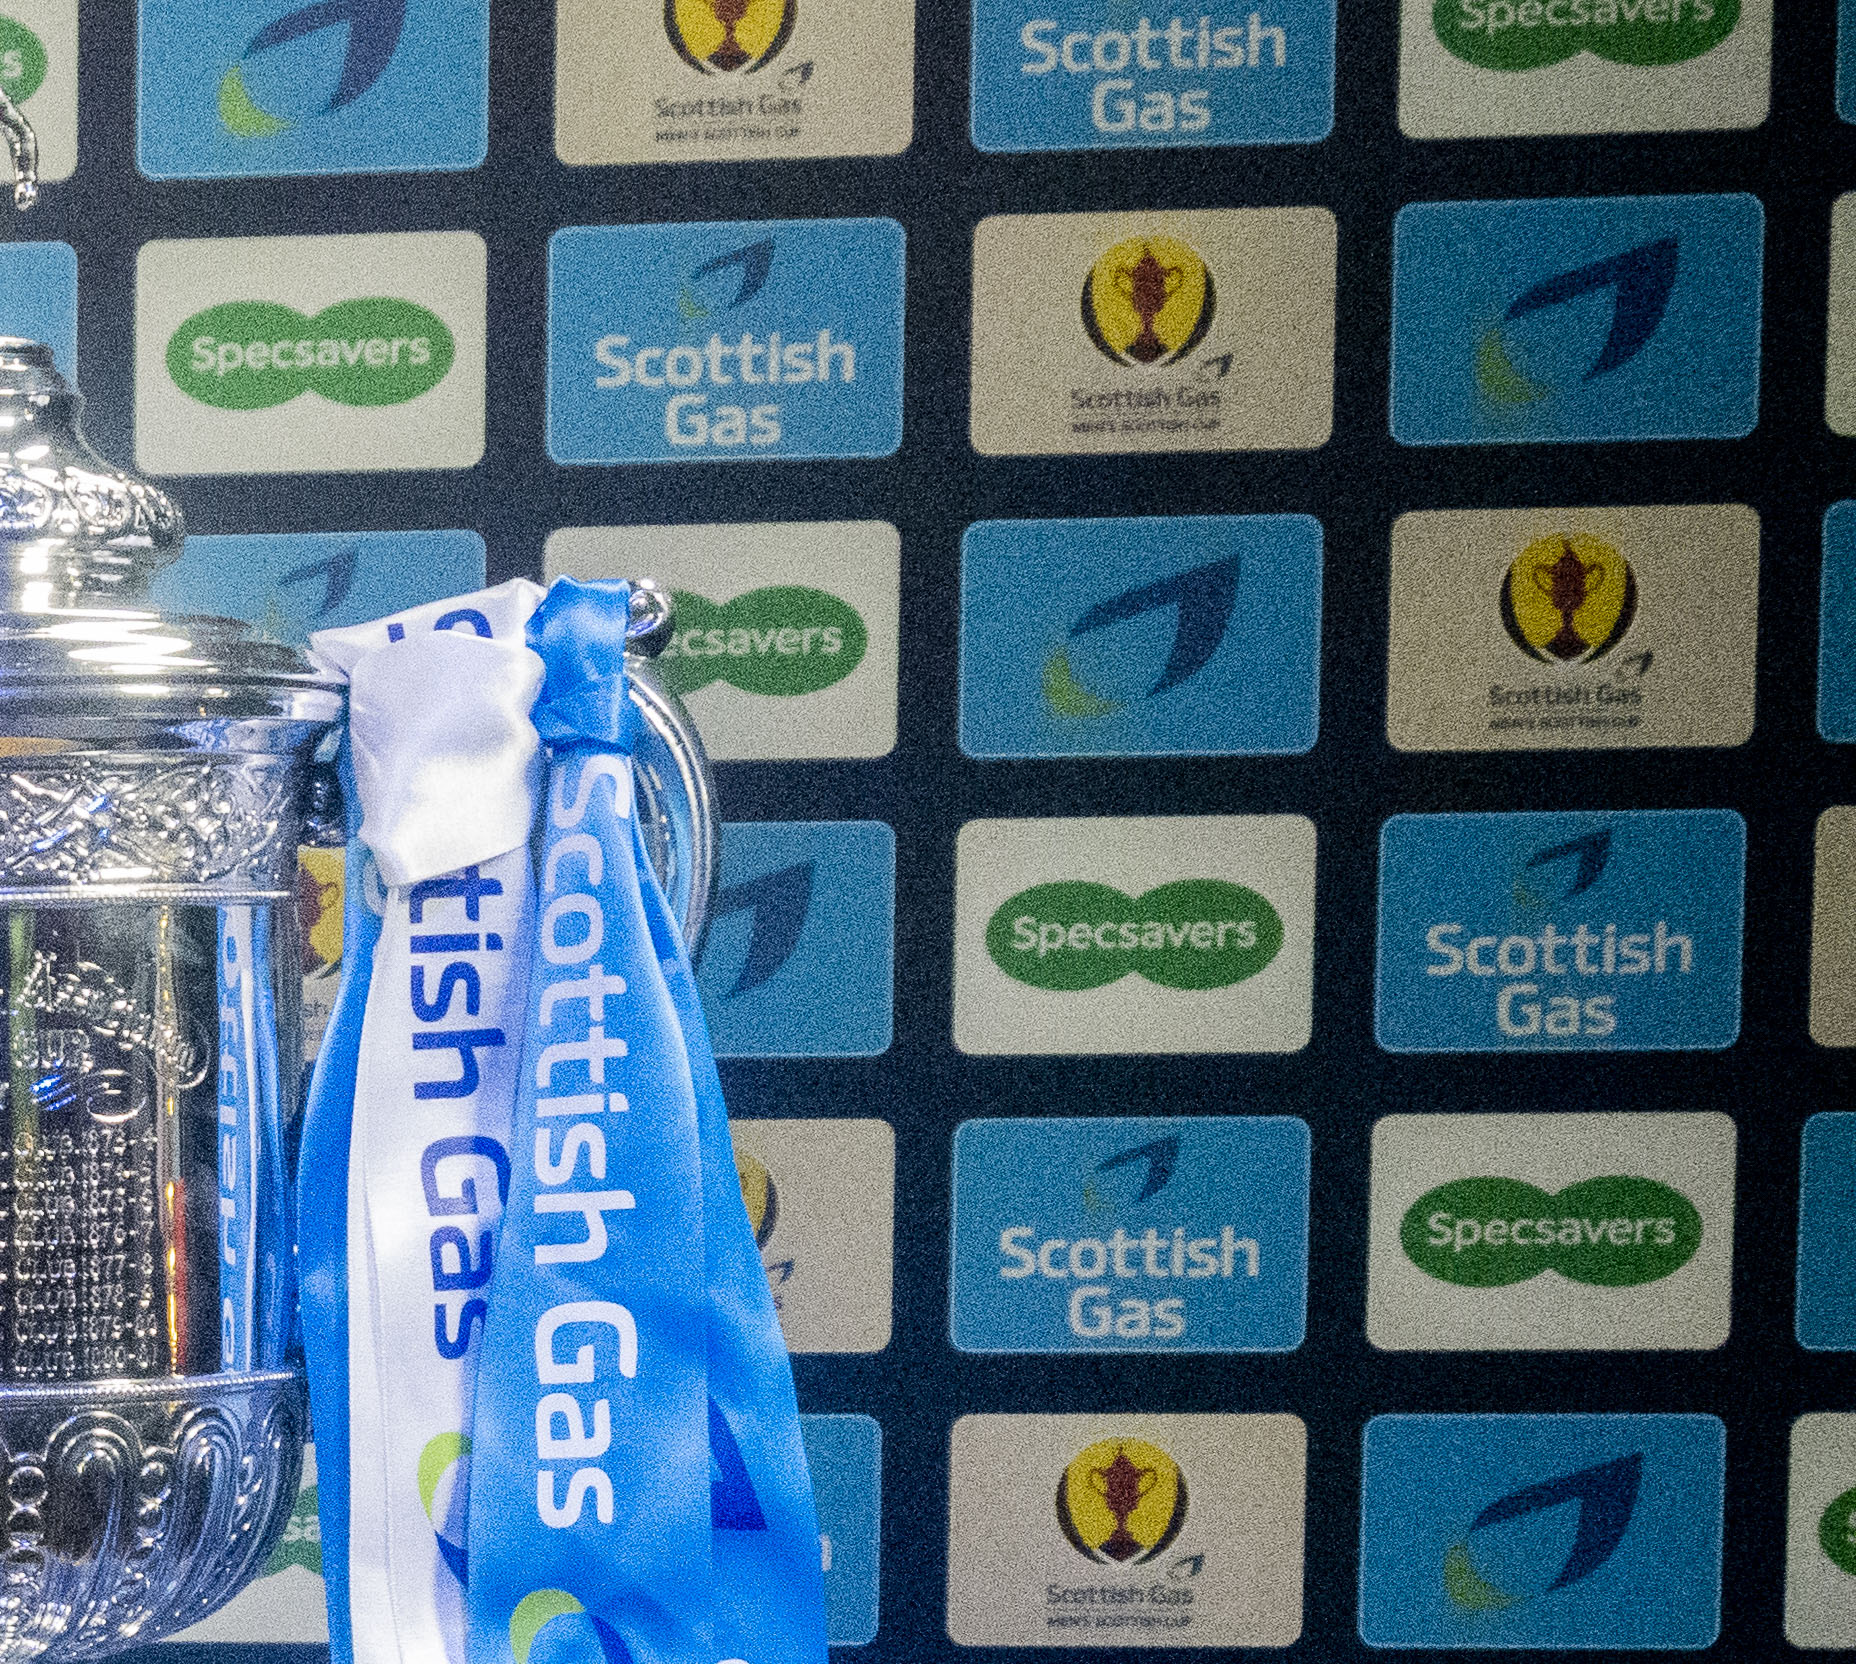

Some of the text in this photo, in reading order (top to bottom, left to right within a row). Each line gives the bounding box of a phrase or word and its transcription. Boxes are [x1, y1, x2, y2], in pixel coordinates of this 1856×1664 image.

[1020, 13, 1285, 75] Scottish
[655, 95, 803, 119] Scottish Gas
[1091, 78, 1211, 134] Gas
[190, 334, 431, 378] Specsavers
[594, 330, 855, 389] Scottish
[664, 393, 781, 447] Gas
[1072, 387, 1222, 411] Scottish Gas
[666, 626, 844, 657] csavers
[1489, 685, 1642, 708] Scottish Gas
[1010, 914, 1258, 958] Specsavers
[1426, 921, 1692, 977] Scottish
[1496, 982, 1617, 1038] Gas
[533, 752, 640, 1529] Scottish Gas
[416, 1134, 513, 1362] Gas
[999, 1225, 1259, 1280] Scottish
[1426, 1209, 1676, 1254] Specsavers
[1067, 1284, 1185, 1339] Gas
[1046, 1586, 1194, 1605] Scottish Gas
